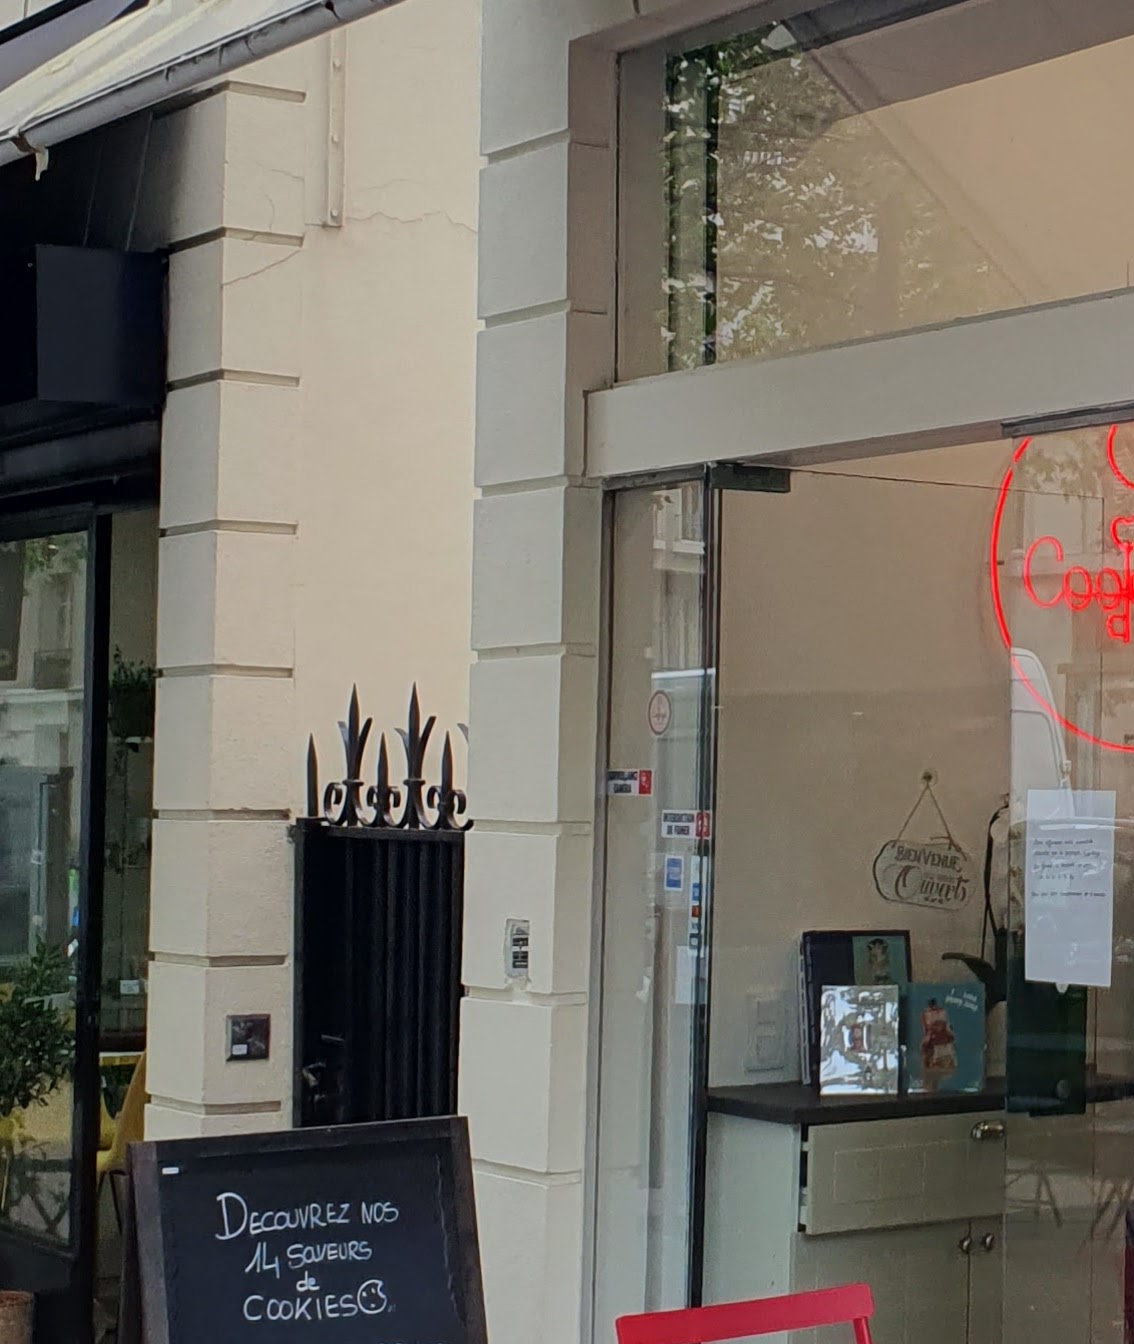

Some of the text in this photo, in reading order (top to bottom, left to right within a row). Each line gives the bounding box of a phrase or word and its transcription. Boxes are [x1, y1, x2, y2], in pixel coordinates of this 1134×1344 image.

[215, 1192, 400, 1241] DECOUVREZ NOS
[244, 1241, 281, 1279] 14
[295, 1270, 320, 1292] de
[243, 1294, 359, 1322] COOKIES
